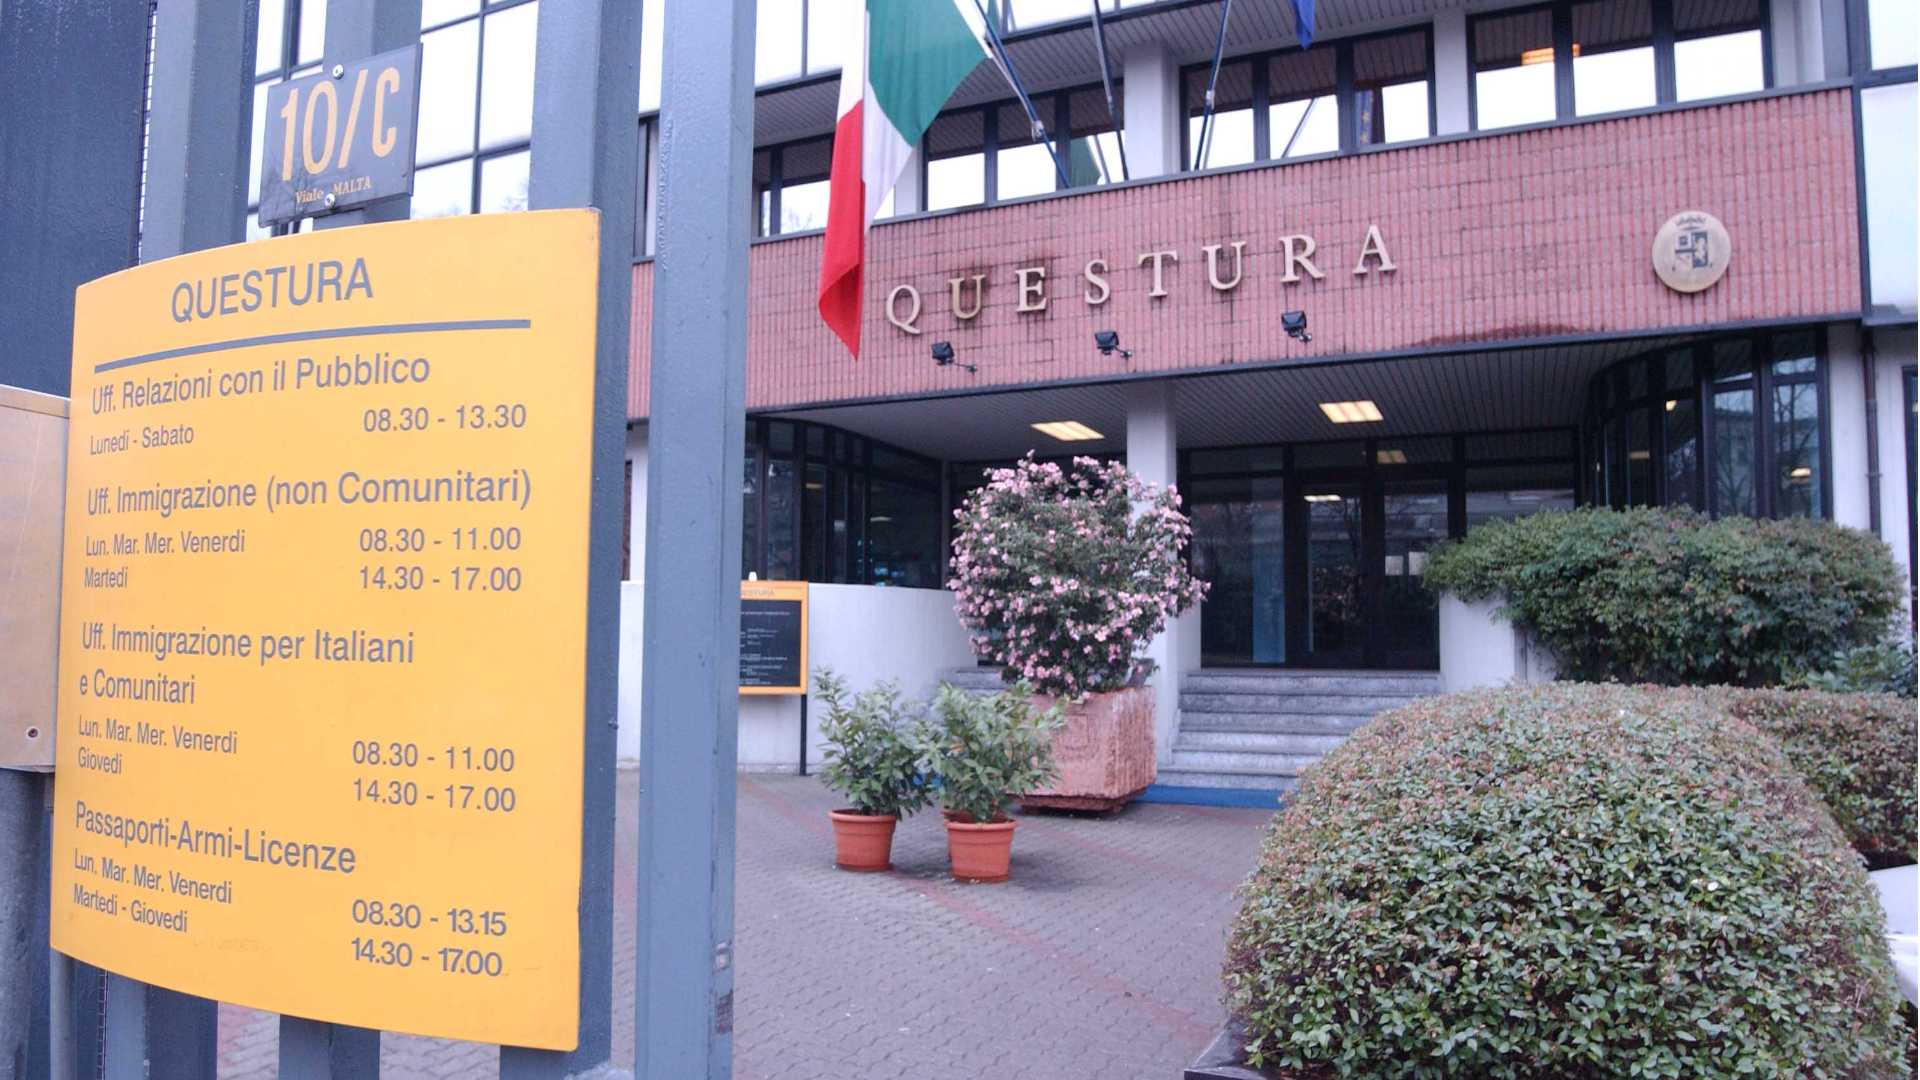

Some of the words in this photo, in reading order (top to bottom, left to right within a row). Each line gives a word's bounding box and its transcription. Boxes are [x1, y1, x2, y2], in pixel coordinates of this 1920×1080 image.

[280, 67, 400, 181] 10/C
[295, 188, 324, 204] Viale
[333, 176, 372, 195] MALTA
[170, 258, 373, 323] QUESTURA
[885, 224, 1397, 334] QUESTURA
[91, 384, 116, 415] Uff.
[122, 369, 212, 408] Relazioni
[219, 367, 263, 397] con
[272, 360, 286, 390] il
[296, 353, 430, 389] Pubblico
[363, 407, 429, 432] 08.30
[456, 404, 526, 430] 13.30
[141, 427, 194, 449] Sabato
[88, 485, 112, 516] Uff.
[117, 479, 256, 517] Immigrazione
[266, 475, 327, 513] (non
[338, 469, 531, 511] Comunitari)
[86, 534, 109, 557] Lun.
[113, 534, 141, 555] Mar.
[144, 532, 175, 554] Mer.
[360, 529, 425, 552] 08.30
[451, 527, 521, 550] 11.00
[359, 566, 424, 590] 14.30
[451, 567, 521, 591] 17.00
[82, 621, 106, 651] Uff.
[112, 624, 251, 660] Immigrazione
[260, 633, 304, 666] per
[315, 629, 414, 663] Italiani
[79, 673, 88, 695] e
[93, 668, 195, 704] Comunitari
[79, 715, 102, 738] Lun.
[106, 718, 133, 742] Mar.
[137, 722, 167, 746] Mer.
[353, 740, 418, 768] 08.30
[446, 746, 514, 772] 11.00
[353, 779, 417, 806] 14.30
[445, 784, 515, 812] 17.00
[76, 799, 356, 872] Passaporti-Armi-Licenze
[74, 848, 98, 875] Lun.
[102, 856, 131, 882] Mar.
[134, 866, 165, 891] Mer.
[351, 900, 421, 929] 08.30
[447, 909, 506, 936] 13.15
[351, 938, 412, 967] 14.30
[438, 947, 502, 977] 17.00
